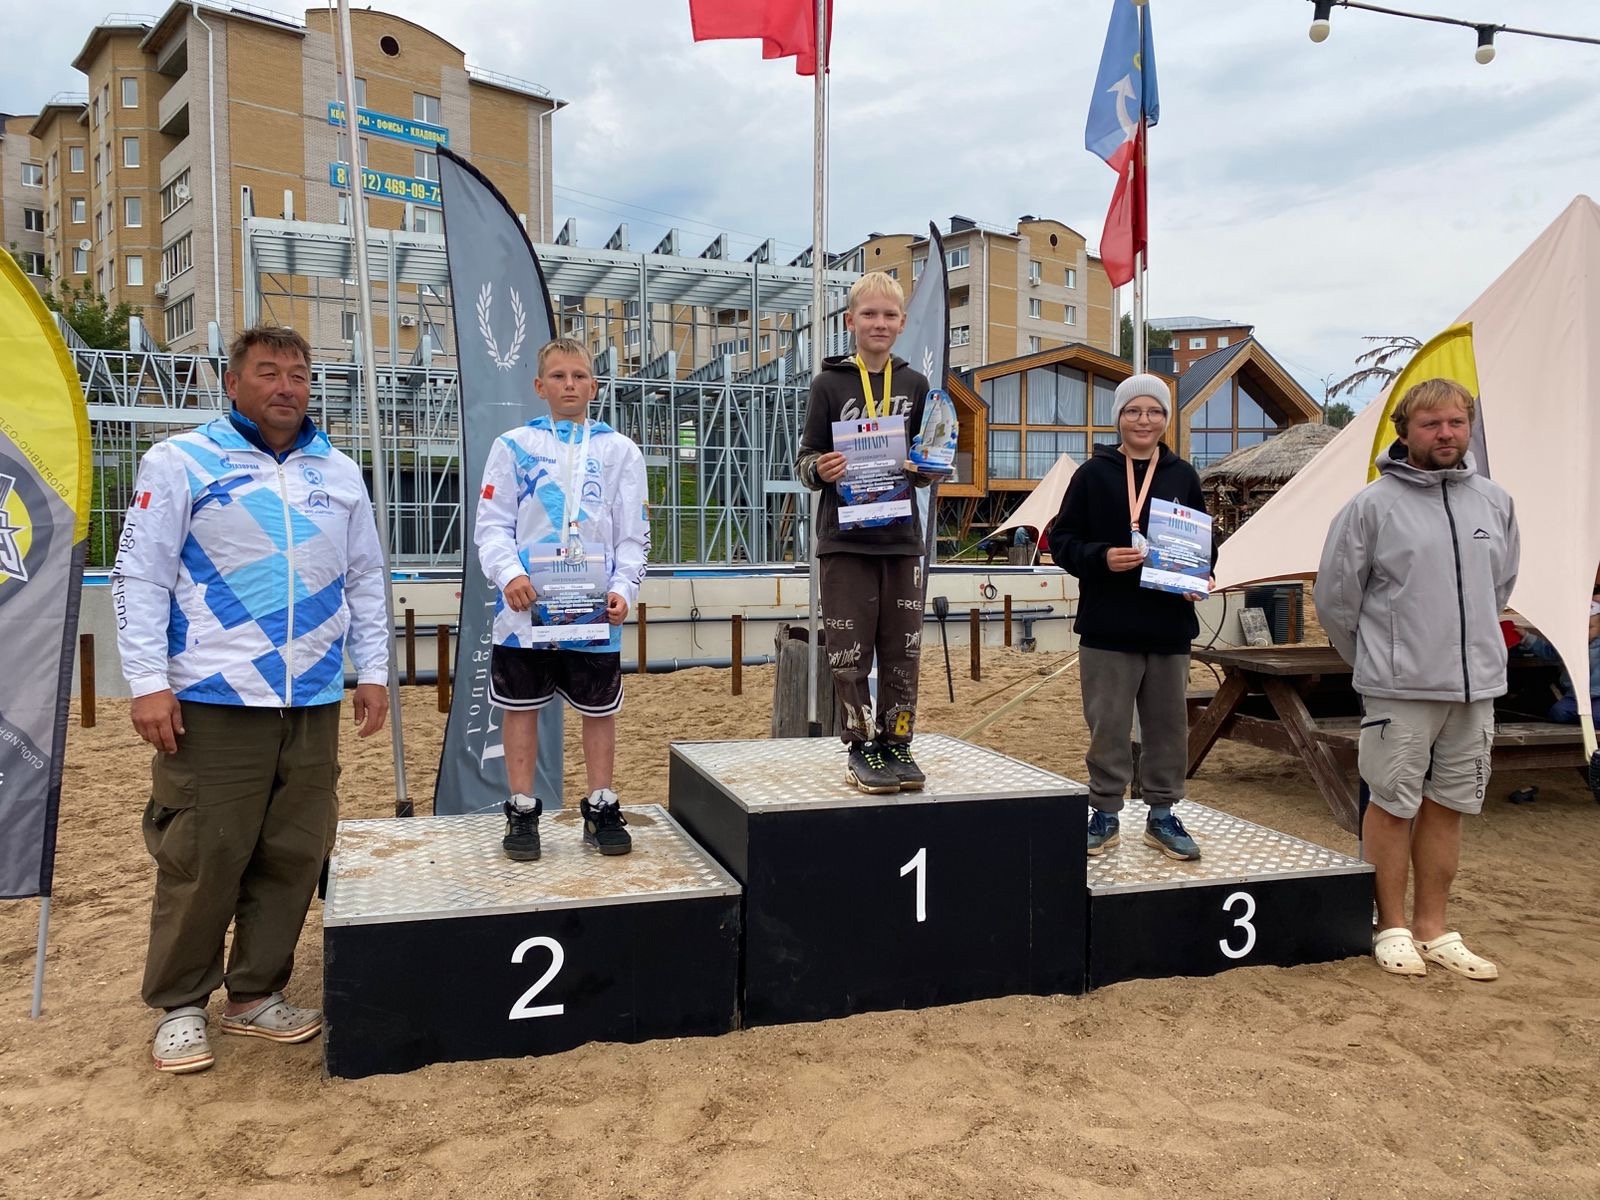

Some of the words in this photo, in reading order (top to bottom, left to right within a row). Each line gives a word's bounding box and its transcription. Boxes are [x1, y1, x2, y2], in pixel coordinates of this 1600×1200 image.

[330, 107, 370, 127] КВАРЫ
[376, 118, 404, 134] ОФИСЫ
[410, 126, 447, 144] КЛАДОВЫЕ
[336, 167, 346, 184] 8
[826, 617, 854, 630] FREE
[897, 598, 922, 611] FREE
[1474, 758, 1484, 800] SMELO
[900, 847, 926, 923] 1
[1219, 891, 1256, 959] 3
[508, 936, 565, 1020] 2
